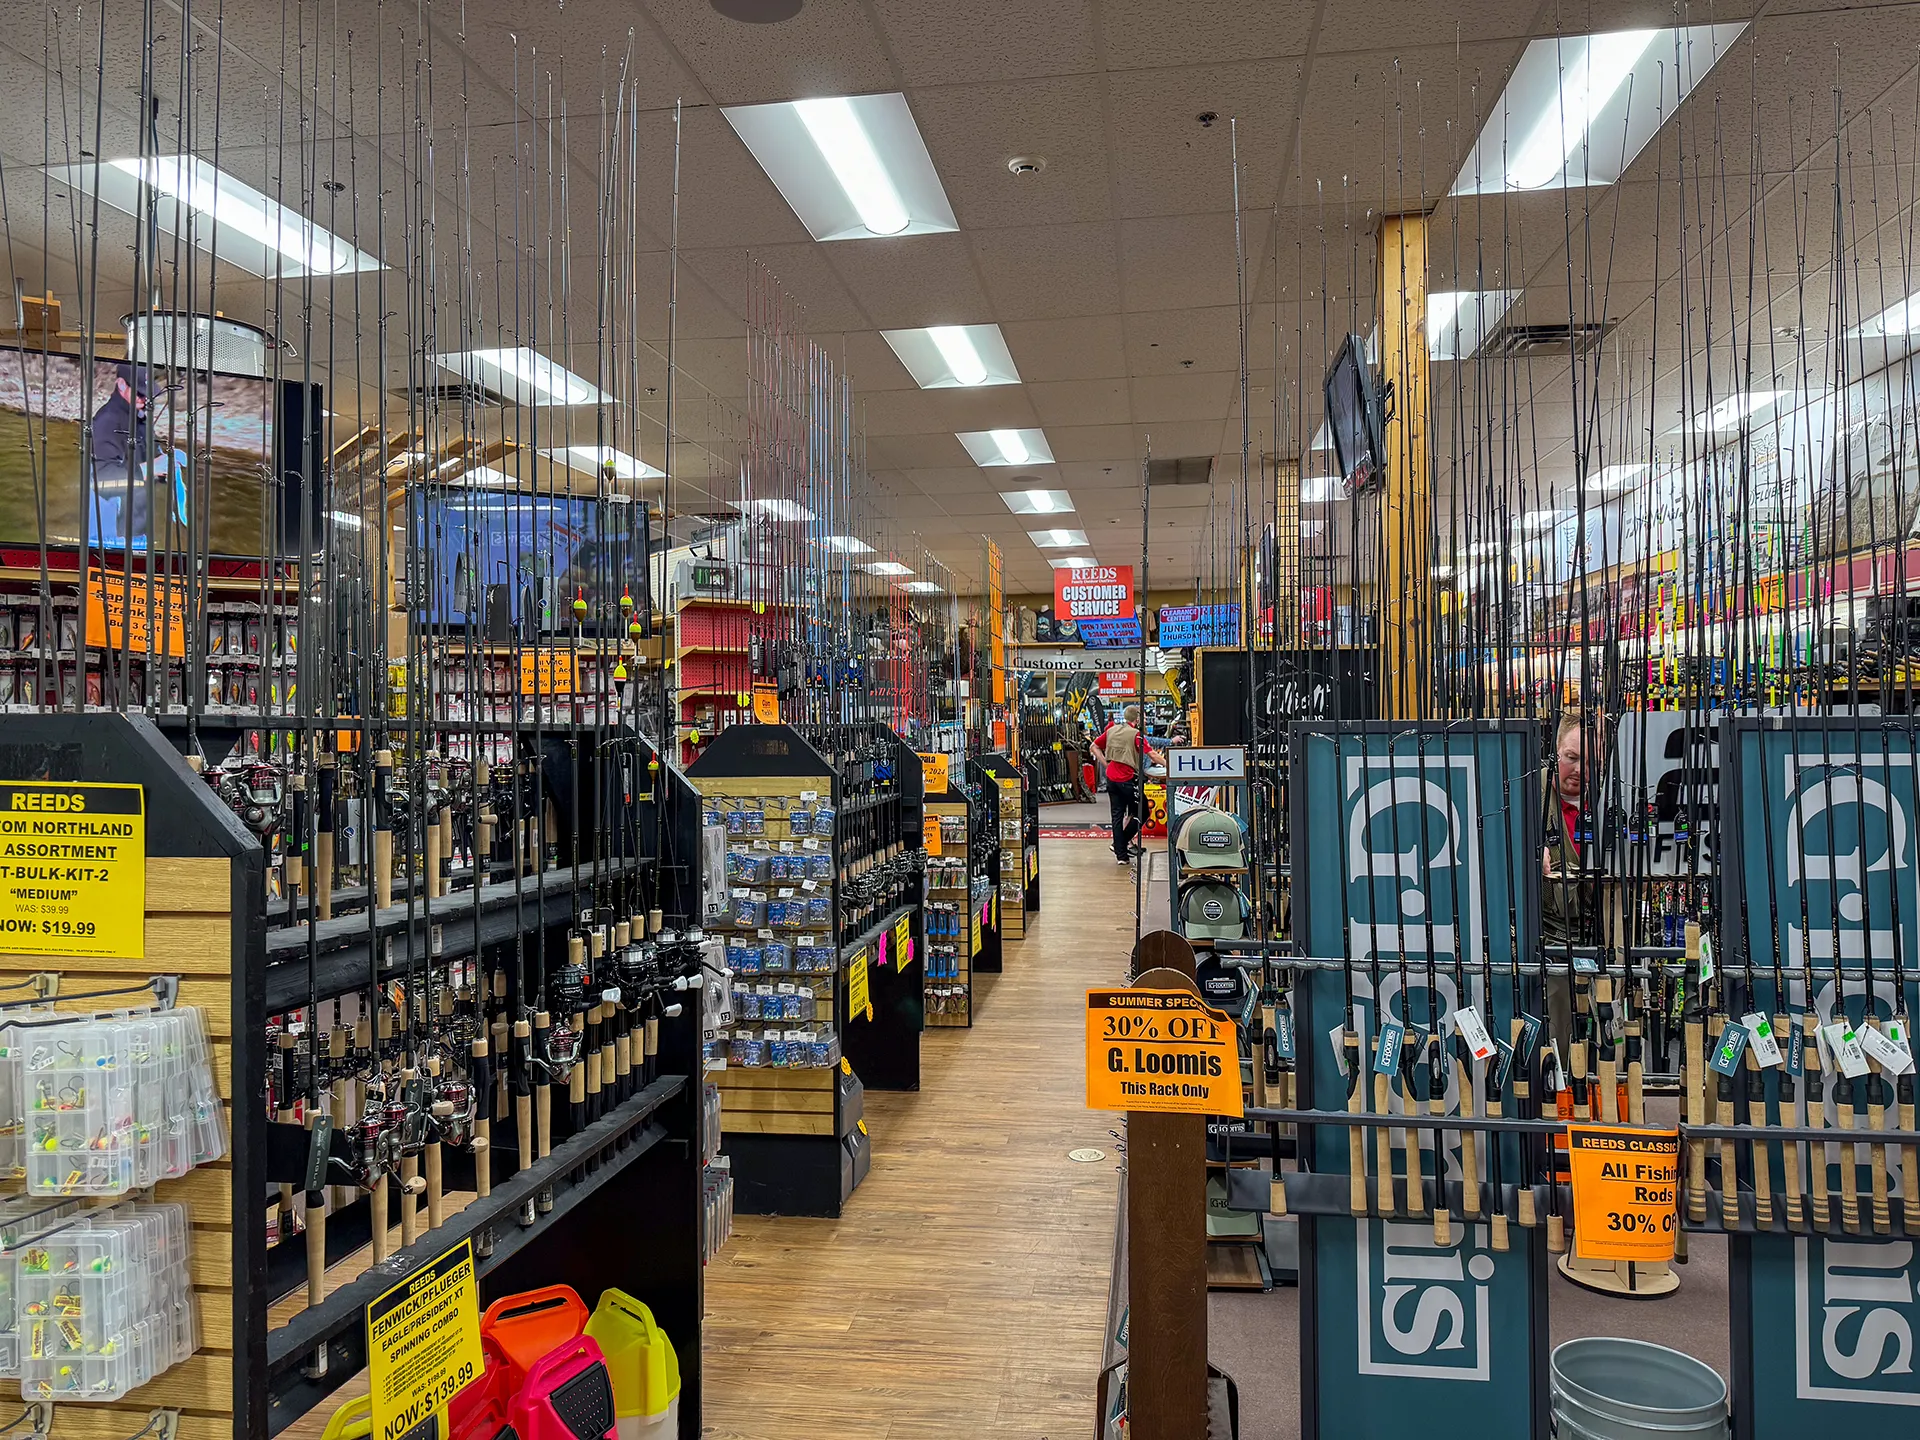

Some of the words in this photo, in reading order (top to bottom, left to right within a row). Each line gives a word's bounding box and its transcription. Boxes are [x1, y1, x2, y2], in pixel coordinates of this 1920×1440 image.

[1072, 567, 1117, 580] REEDS
[1062, 584, 1127, 601] CUSTOMER
[1070, 600, 1119, 616] SERVICE
[1162, 624, 1189, 633] JUNE:
[1014, 657, 1084, 670] Customer
[929, 767, 945, 775] 2024
[1178, 754, 1235, 772] Huk
[11, 792, 86, 813] REEDS
[32, 821, 133, 836] NORTHLAND
[4, 843, 118, 859] ASSORTMENT
[15, 904, 39, 913] WAS:
[40, 905, 69, 915] $39.99
[41, 920, 96, 935] $19.99
[1109, 996, 1163, 1007] SUMMER
[721, 1013, 730, 1021] 13
[1103, 1015, 1159, 1038] 30%
[1168, 1017, 1221, 1039] OFF
[1108, 1047, 1129, 1072] G.
[1134, 1048, 1223, 1077] Loomis
[1120, 1081, 1147, 1095] This
[1149, 1082, 1180, 1097] Rack
[1182, 1084, 1210, 1099] Only
[1581, 1137, 1626, 1150] REEDS
[1629, 1140, 1677, 1153] CLASSIC
[1601, 1162, 1628, 1179] All
[1634, 1186, 1673, 1203] Rods
[1607, 1212, 1656, 1234] 30%
[1662, 1214, 1677, 1233] OF
[409, 1269, 436, 1296] REEDS
[372, 1262, 472, 1341] FENWICK/PFLUEGER
[382, 1295, 454, 1352] EAGLE/PRESIDENT
[454, 1287, 464, 1303] XT
[390, 1329, 431, 1364] SPINNING
[432, 1307, 459, 1333] COMBO
[411, 1383, 427, 1398] WAS:
